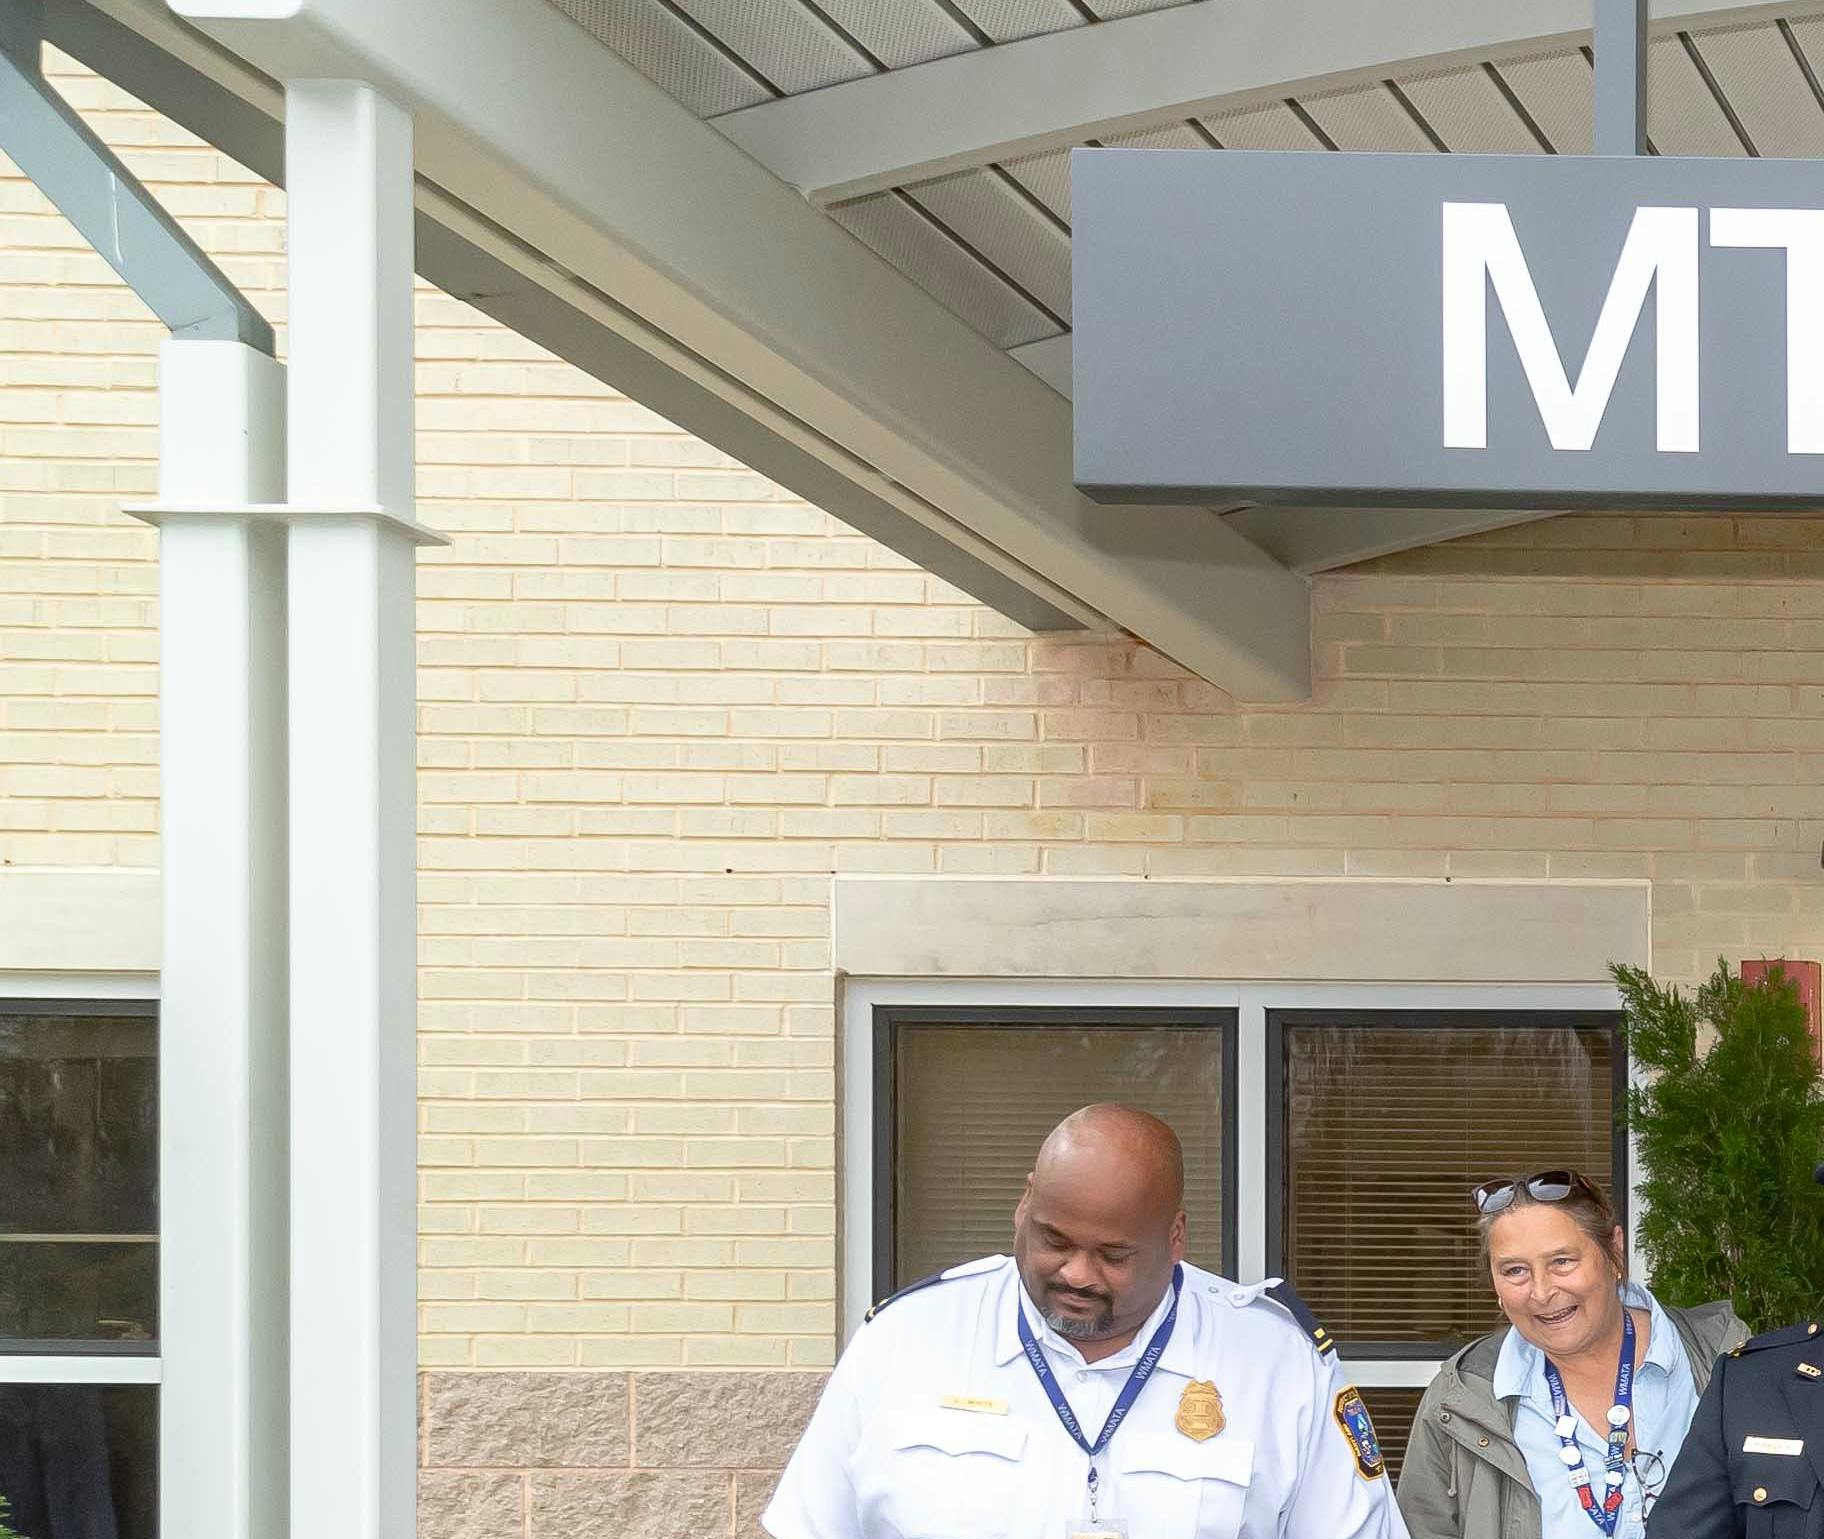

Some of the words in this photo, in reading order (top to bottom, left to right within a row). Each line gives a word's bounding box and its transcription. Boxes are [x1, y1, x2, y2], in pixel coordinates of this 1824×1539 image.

[1025, 1339, 1048, 1378] WMATA
[1135, 1346, 1161, 1380] WMATA
[1618, 1363, 1631, 1396] WMATA
[1058, 1402, 1083, 1440] WMATA
[1101, 1408, 1126, 1443] WMATA
